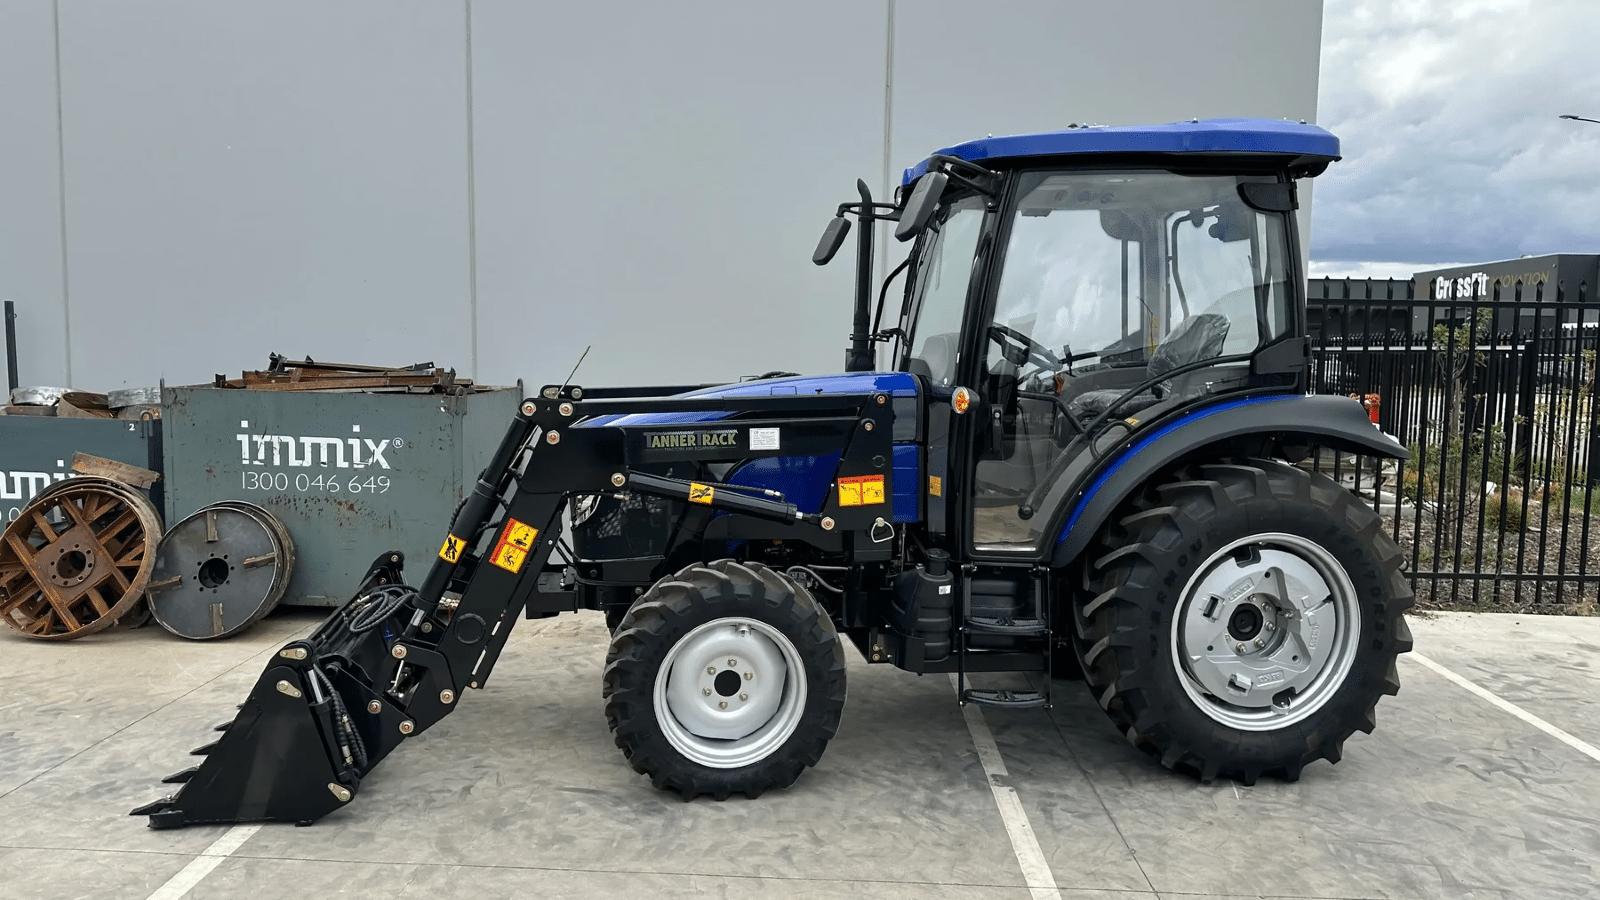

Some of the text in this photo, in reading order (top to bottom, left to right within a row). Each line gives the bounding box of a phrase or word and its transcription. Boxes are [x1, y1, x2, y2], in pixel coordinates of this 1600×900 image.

[129, 423, 135, 431] 2
[242, 471, 391, 494] 1300 046 649
